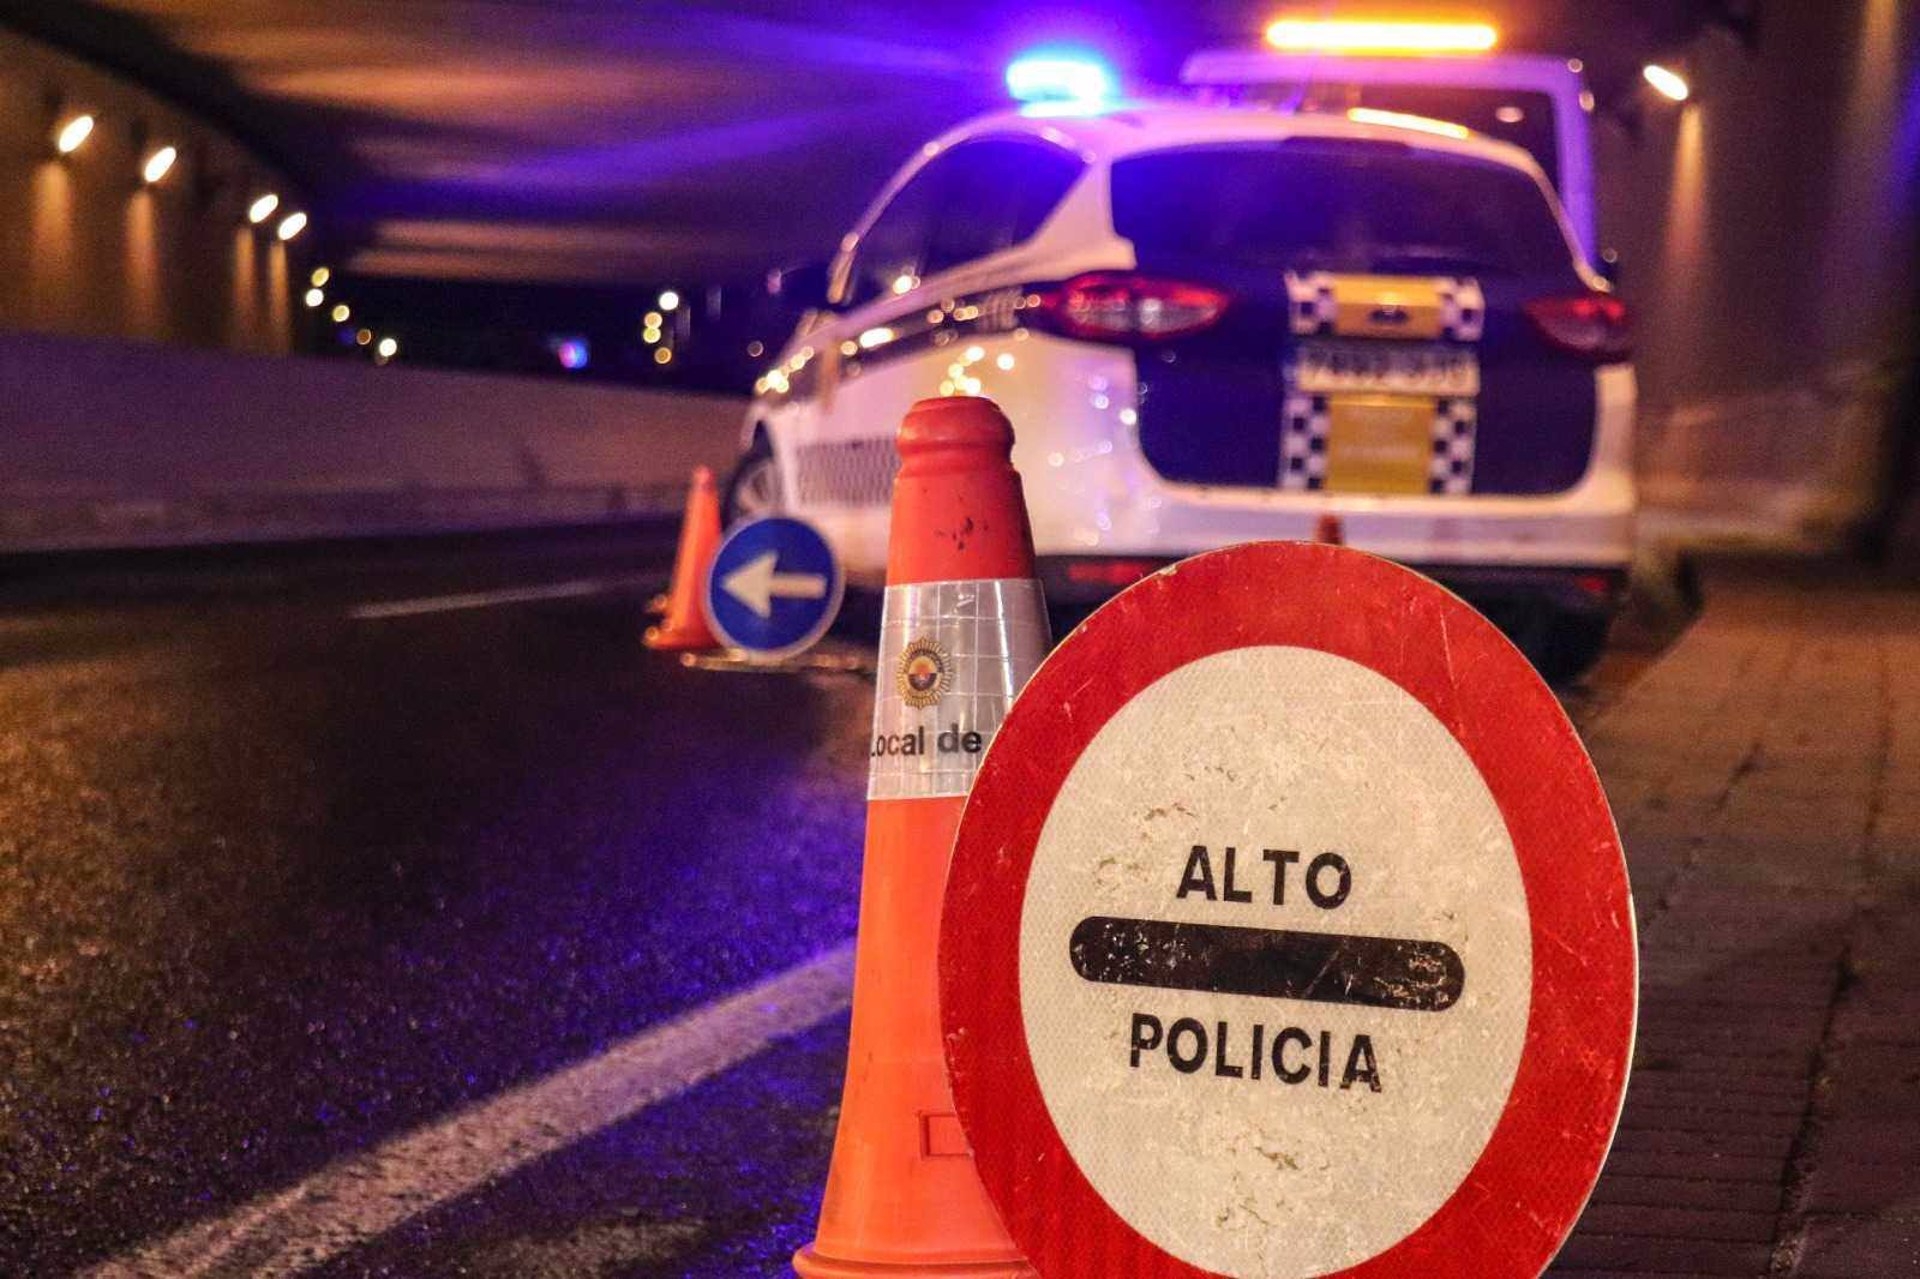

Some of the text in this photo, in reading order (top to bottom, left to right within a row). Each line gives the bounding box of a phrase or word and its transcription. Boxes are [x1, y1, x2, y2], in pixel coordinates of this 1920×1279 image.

[871, 723, 983, 757] ocal de
[1176, 845, 1352, 910] ALTO
[1129, 1012, 1383, 1094] POLICIA
